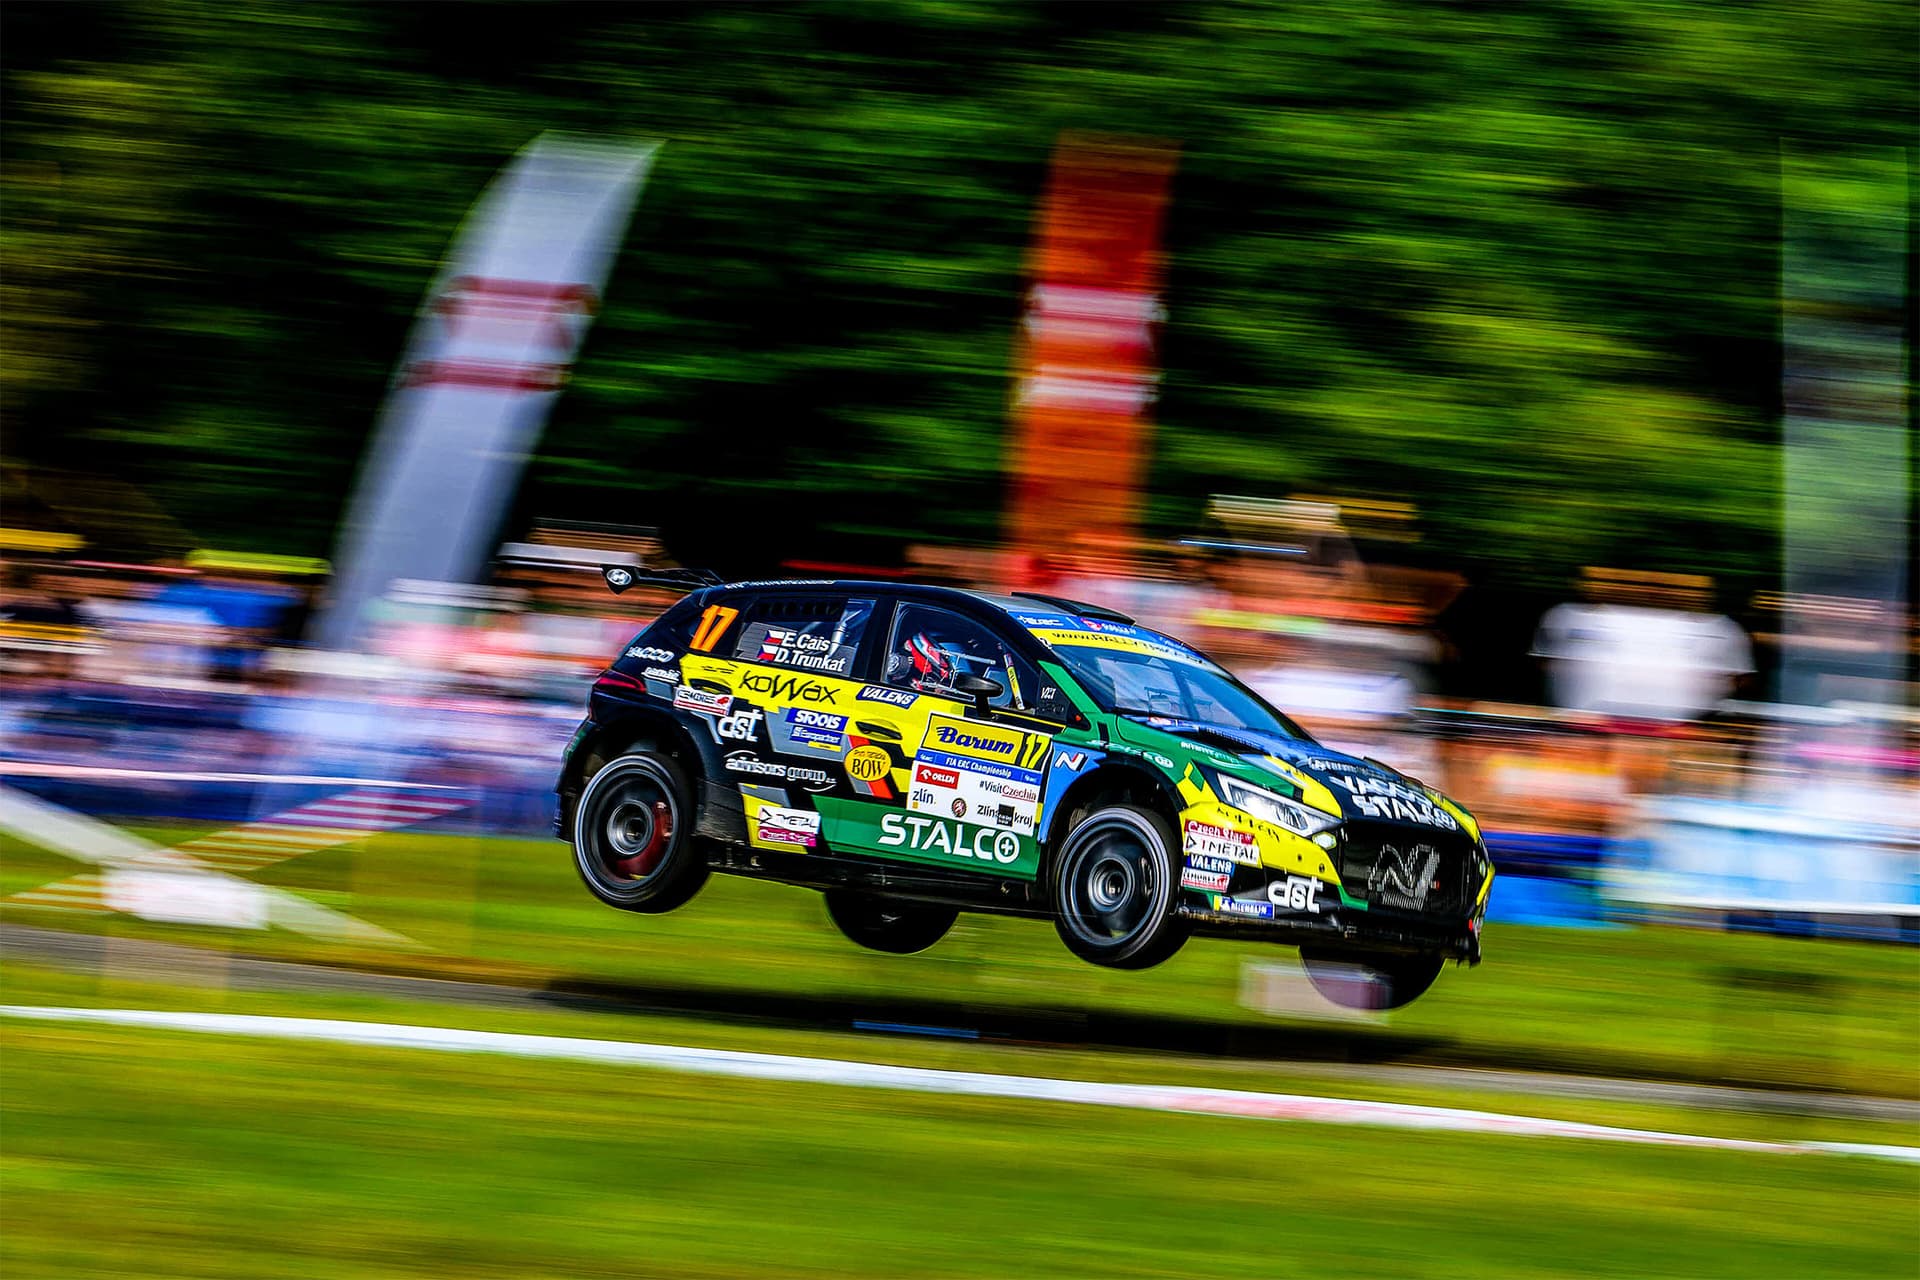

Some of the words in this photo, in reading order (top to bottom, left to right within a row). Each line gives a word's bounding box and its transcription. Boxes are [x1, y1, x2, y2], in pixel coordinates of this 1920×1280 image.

[689, 604, 739, 653] 17
[862, 687, 914, 705] VALENS
[936, 726, 1015, 755] Barum
[1020, 732, 1051, 769] 17
[970, 761, 1012, 779] Championship
[878, 813, 1020, 864] STALCO
[1267, 875, 1323, 913] dst
